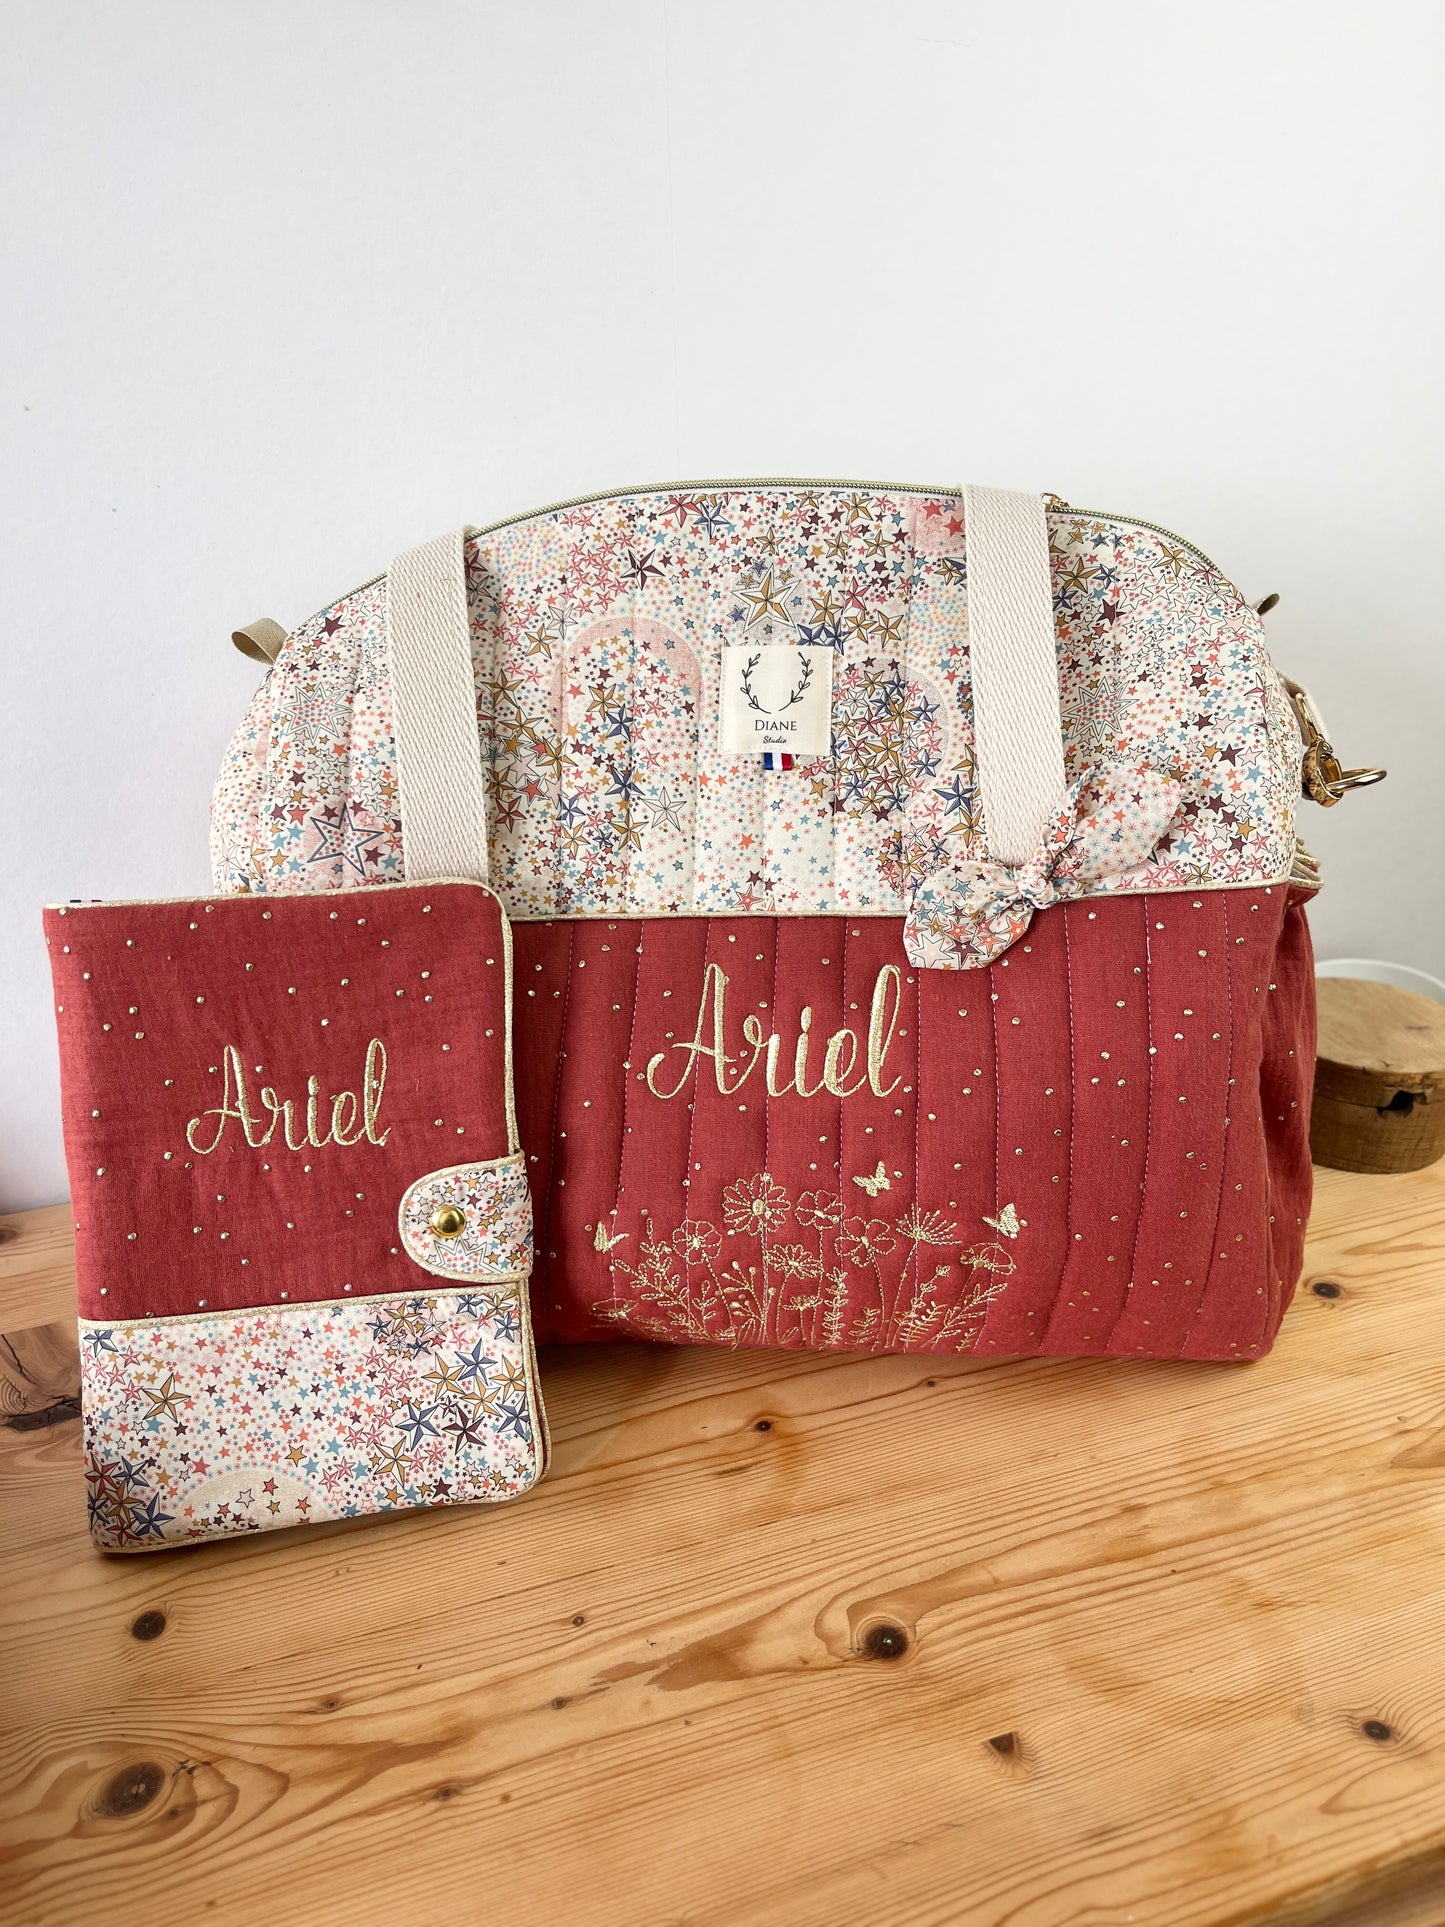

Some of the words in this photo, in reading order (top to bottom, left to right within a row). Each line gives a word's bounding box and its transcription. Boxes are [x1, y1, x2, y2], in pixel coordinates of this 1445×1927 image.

[754, 719, 797, 731] DIANE
[762, 735, 787, 744] Studio
[646, 963, 902, 1099] Ariel
[186, 1037, 392, 1155] Ariel
